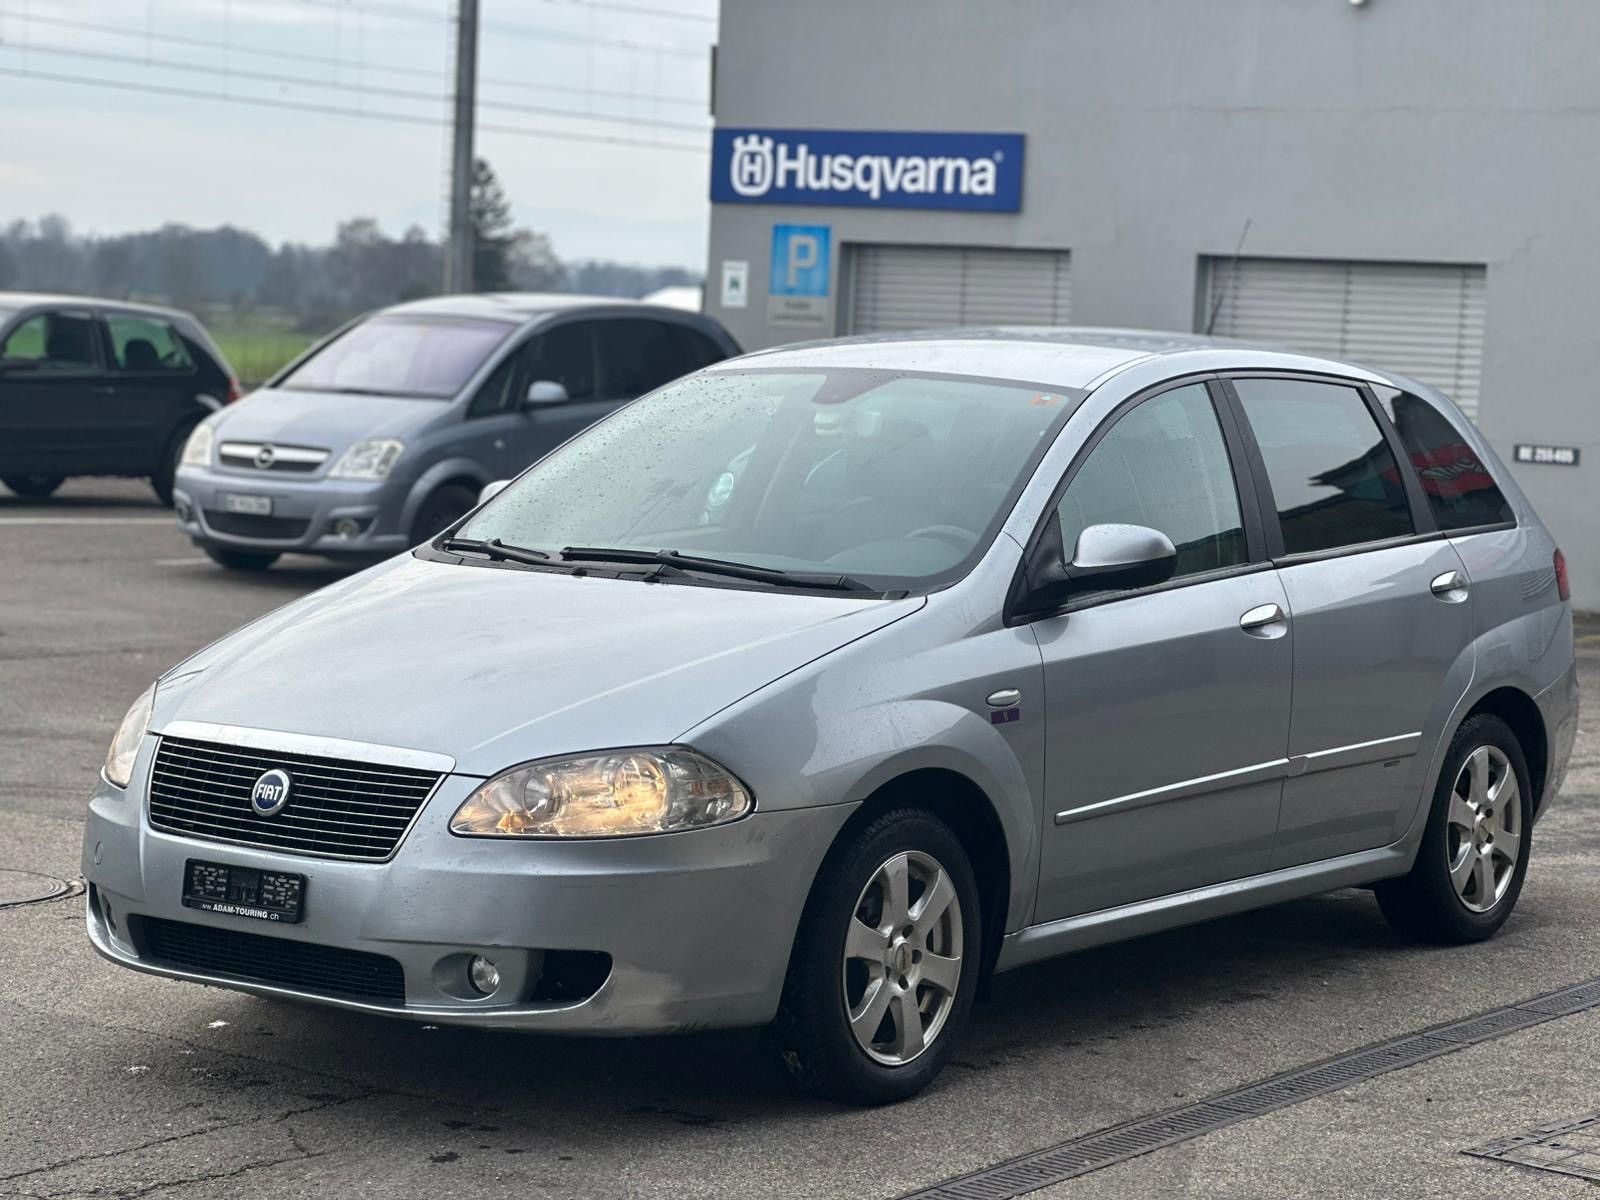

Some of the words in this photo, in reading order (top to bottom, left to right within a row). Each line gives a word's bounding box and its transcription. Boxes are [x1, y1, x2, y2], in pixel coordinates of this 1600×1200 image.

[775, 143, 996, 200] Husqvarna
[787, 233, 818, 288] P
[256, 783, 283, 801] FIAT
